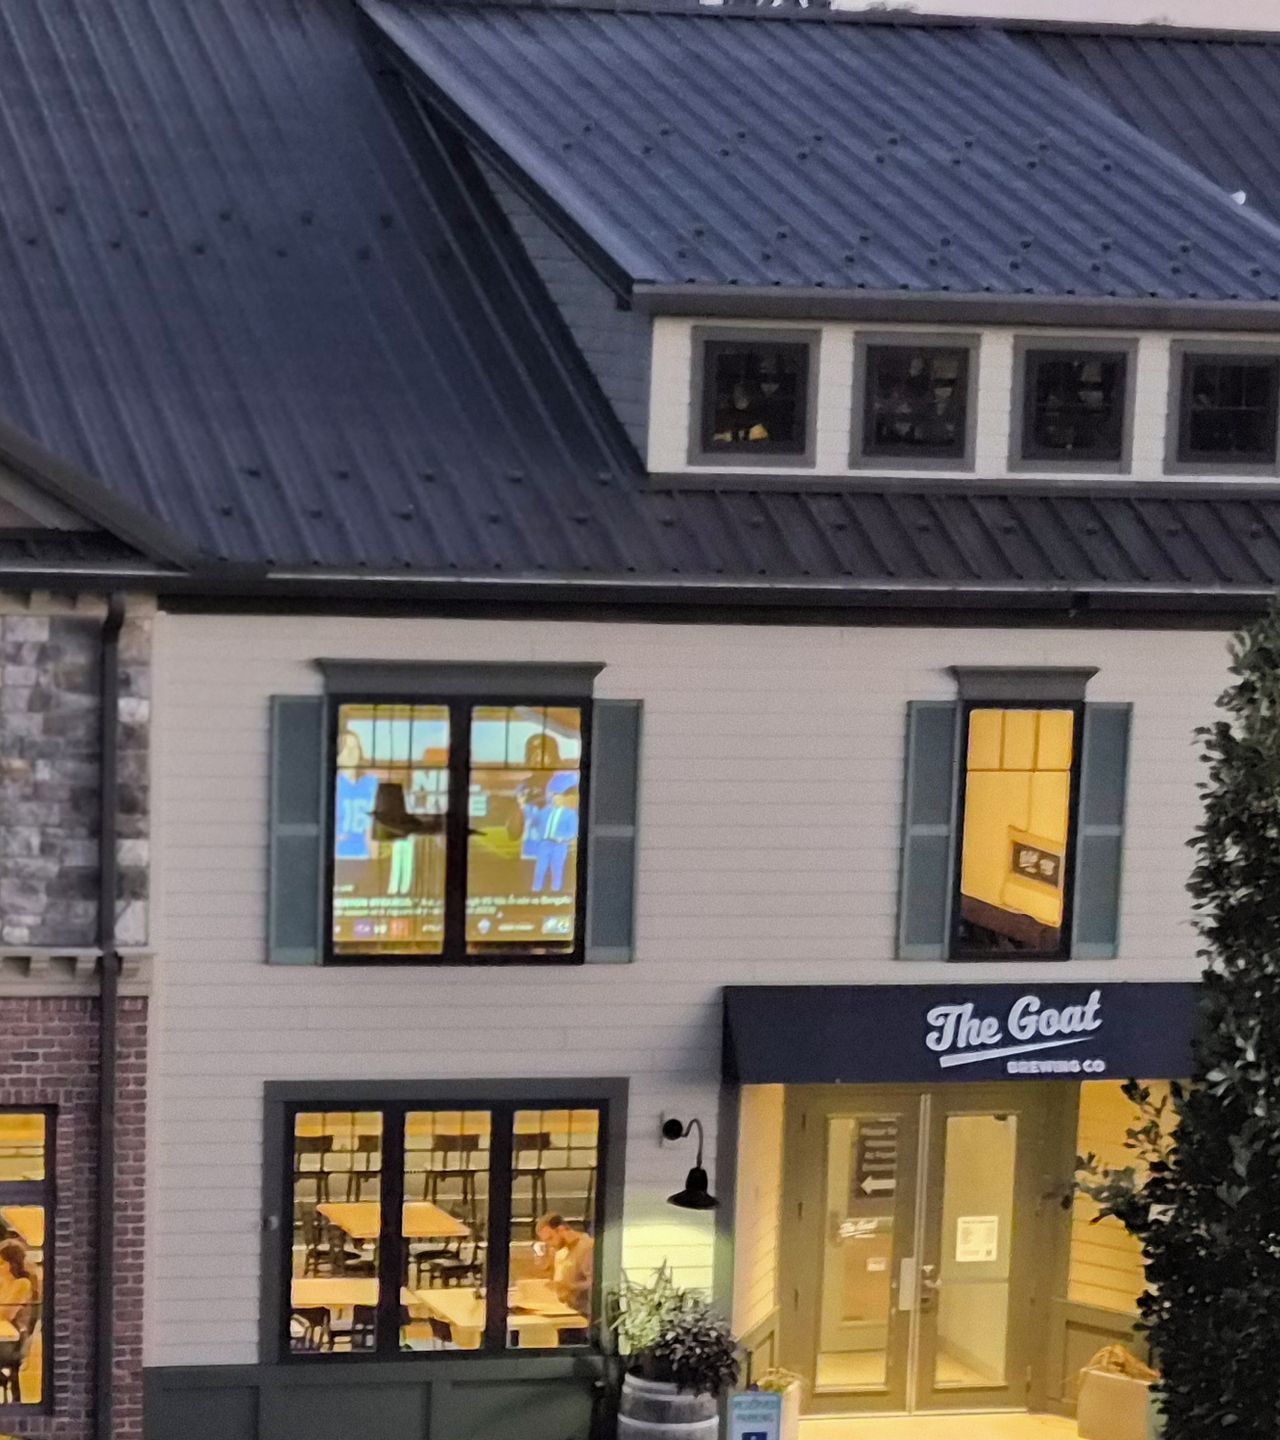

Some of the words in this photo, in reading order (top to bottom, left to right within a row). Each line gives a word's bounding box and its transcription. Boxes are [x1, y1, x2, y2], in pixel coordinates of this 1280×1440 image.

[925, 1003, 1003, 1051] The
[1007, 989, 1103, 1040] Goat
[1007, 1059, 1081, 1074] BREWING
[1082, 1059, 1106, 1073] CO
[736, 1413, 774, 1423] PARKING
